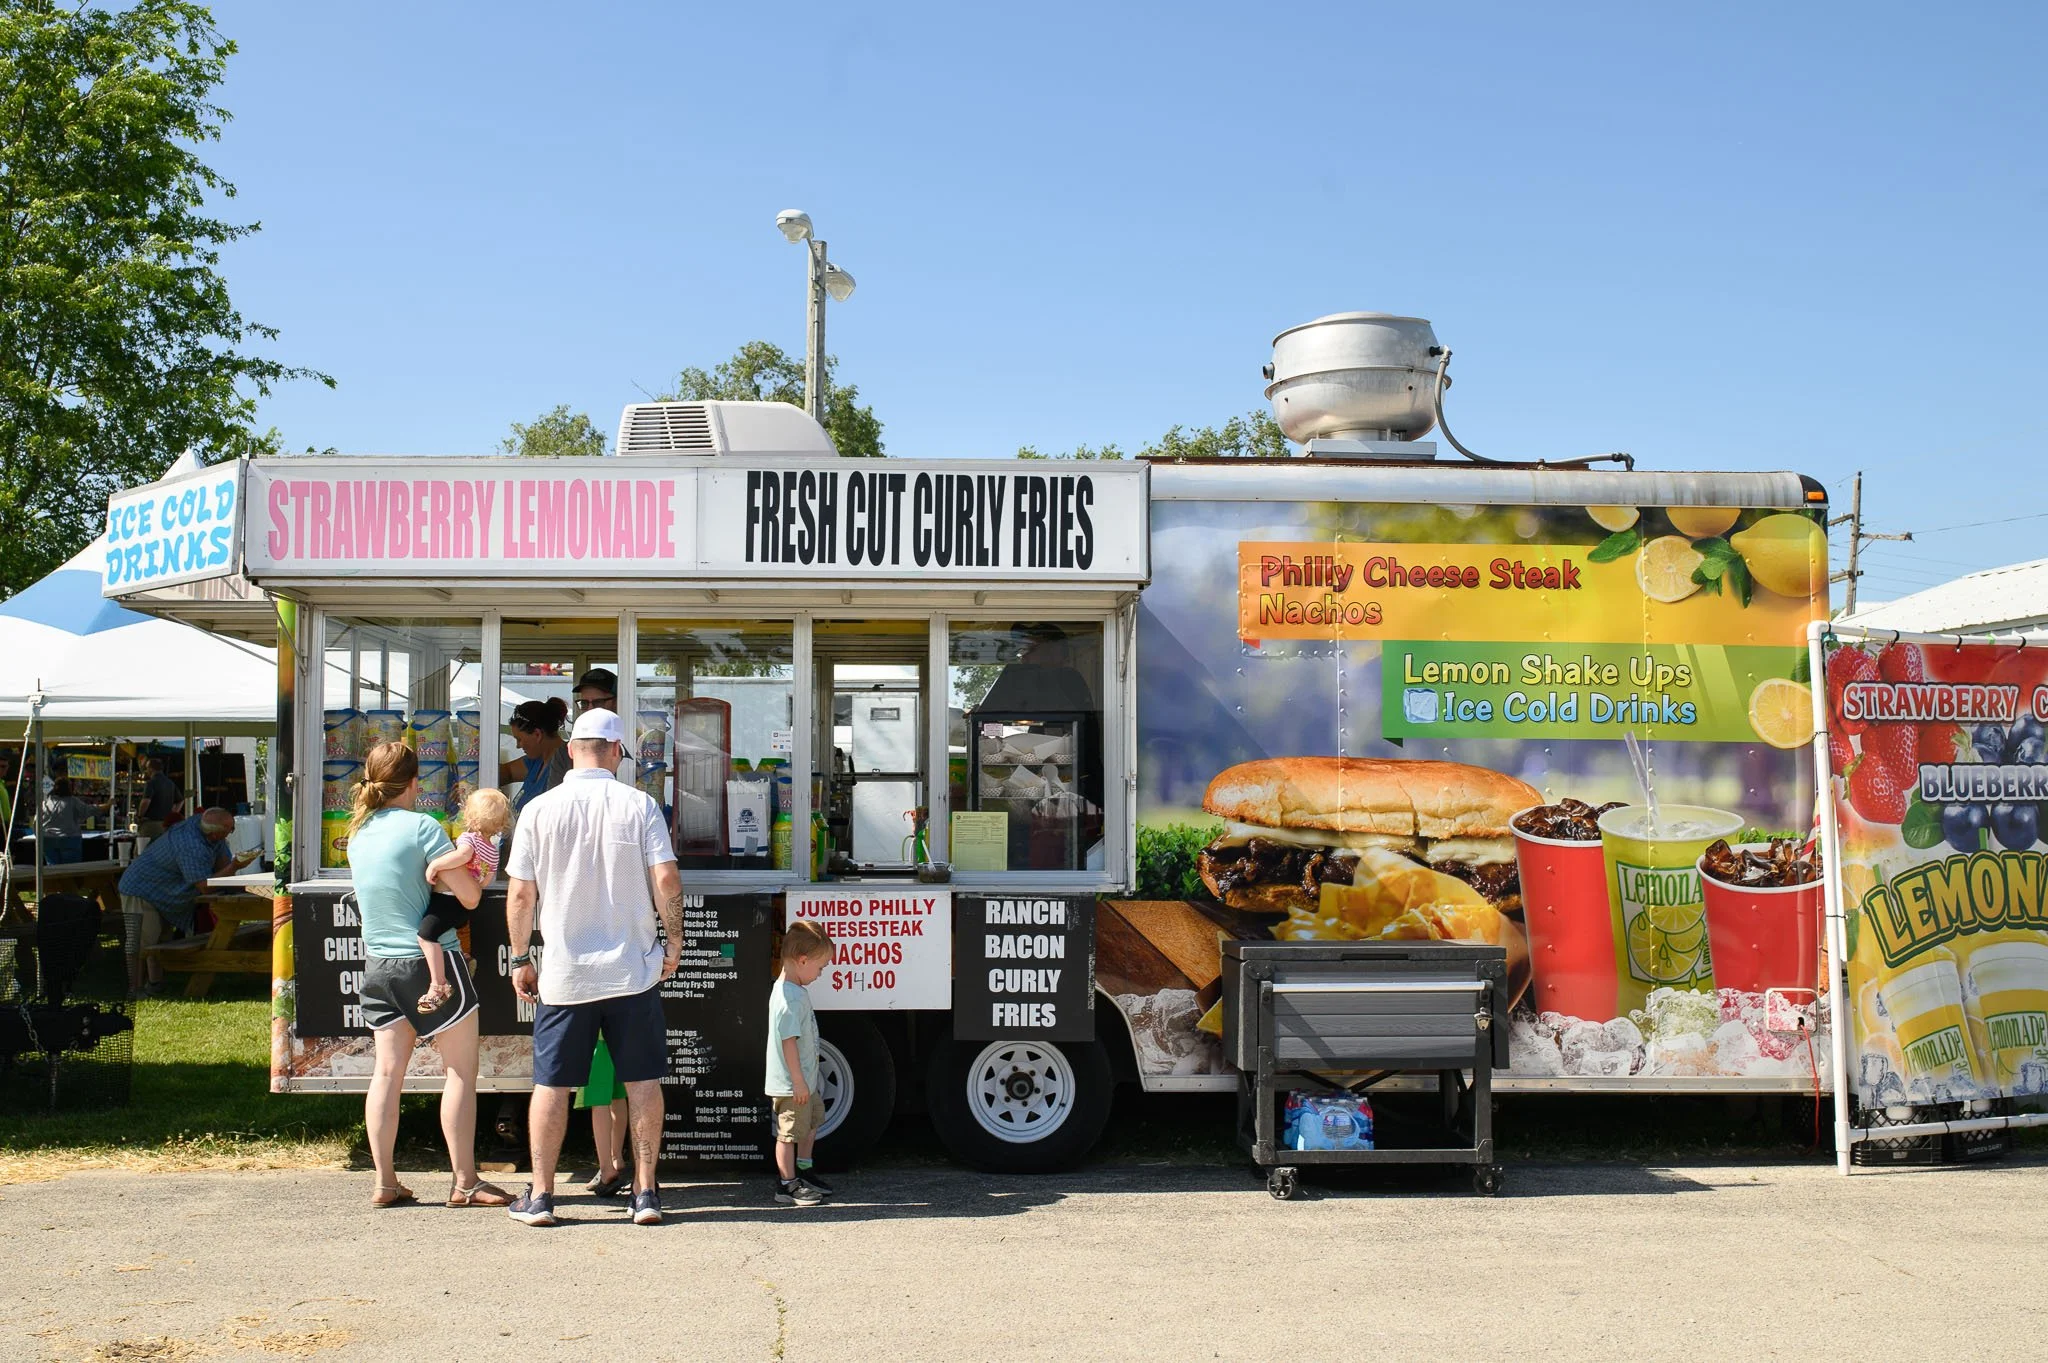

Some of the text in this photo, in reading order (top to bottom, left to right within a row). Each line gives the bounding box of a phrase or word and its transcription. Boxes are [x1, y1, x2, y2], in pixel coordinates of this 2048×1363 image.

[108, 480, 234, 543] ICE COLD
[268, 478, 675, 561] STRAWBERRY LEMONADE
[745, 470, 1094, 571] FRESH CUT CURLY FRIES
[106, 526, 231, 585] DRINKS
[1260, 556, 1581, 592] Philly Cheese Steak
[1259, 594, 1382, 625] Nachos
[1403, 653, 1692, 692] Lemon Shake Ups
[1443, 692, 1697, 725] Ice Cold Drinks
[1844, 684, 2018, 721] STRAWBERRY
[1920, 765, 2048, 801] BLUEBERR
[1621, 866, 1704, 906] LemonA
[683, 895, 704, 908] NU
[796, 898, 936, 917] JUMBO PHILLY
[985, 901, 1065, 925] RANCH
[1863, 851, 2048, 968] LEMON
[683, 920, 718, 928] Nacho-$12
[685, 911, 718, 919] Steak-$12
[684, 930, 739, 939] Steak Nacho-$14
[822, 920, 924, 938] EESESTEAK
[324, 937, 367, 961] CHED
[681, 949, 722, 957] eeseburger-
[985, 935, 1065, 959] BACON
[691, 981, 715, 989] Fry-$10
[832, 970, 895, 992] $14.00
[988, 969, 1061, 993] CURLY
[659, 990, 693, 998] opping-$1
[992, 1003, 1056, 1027] FRIES
[666, 1029, 697, 1037] hake-ups
[680, 1075, 696, 1085] Pop
